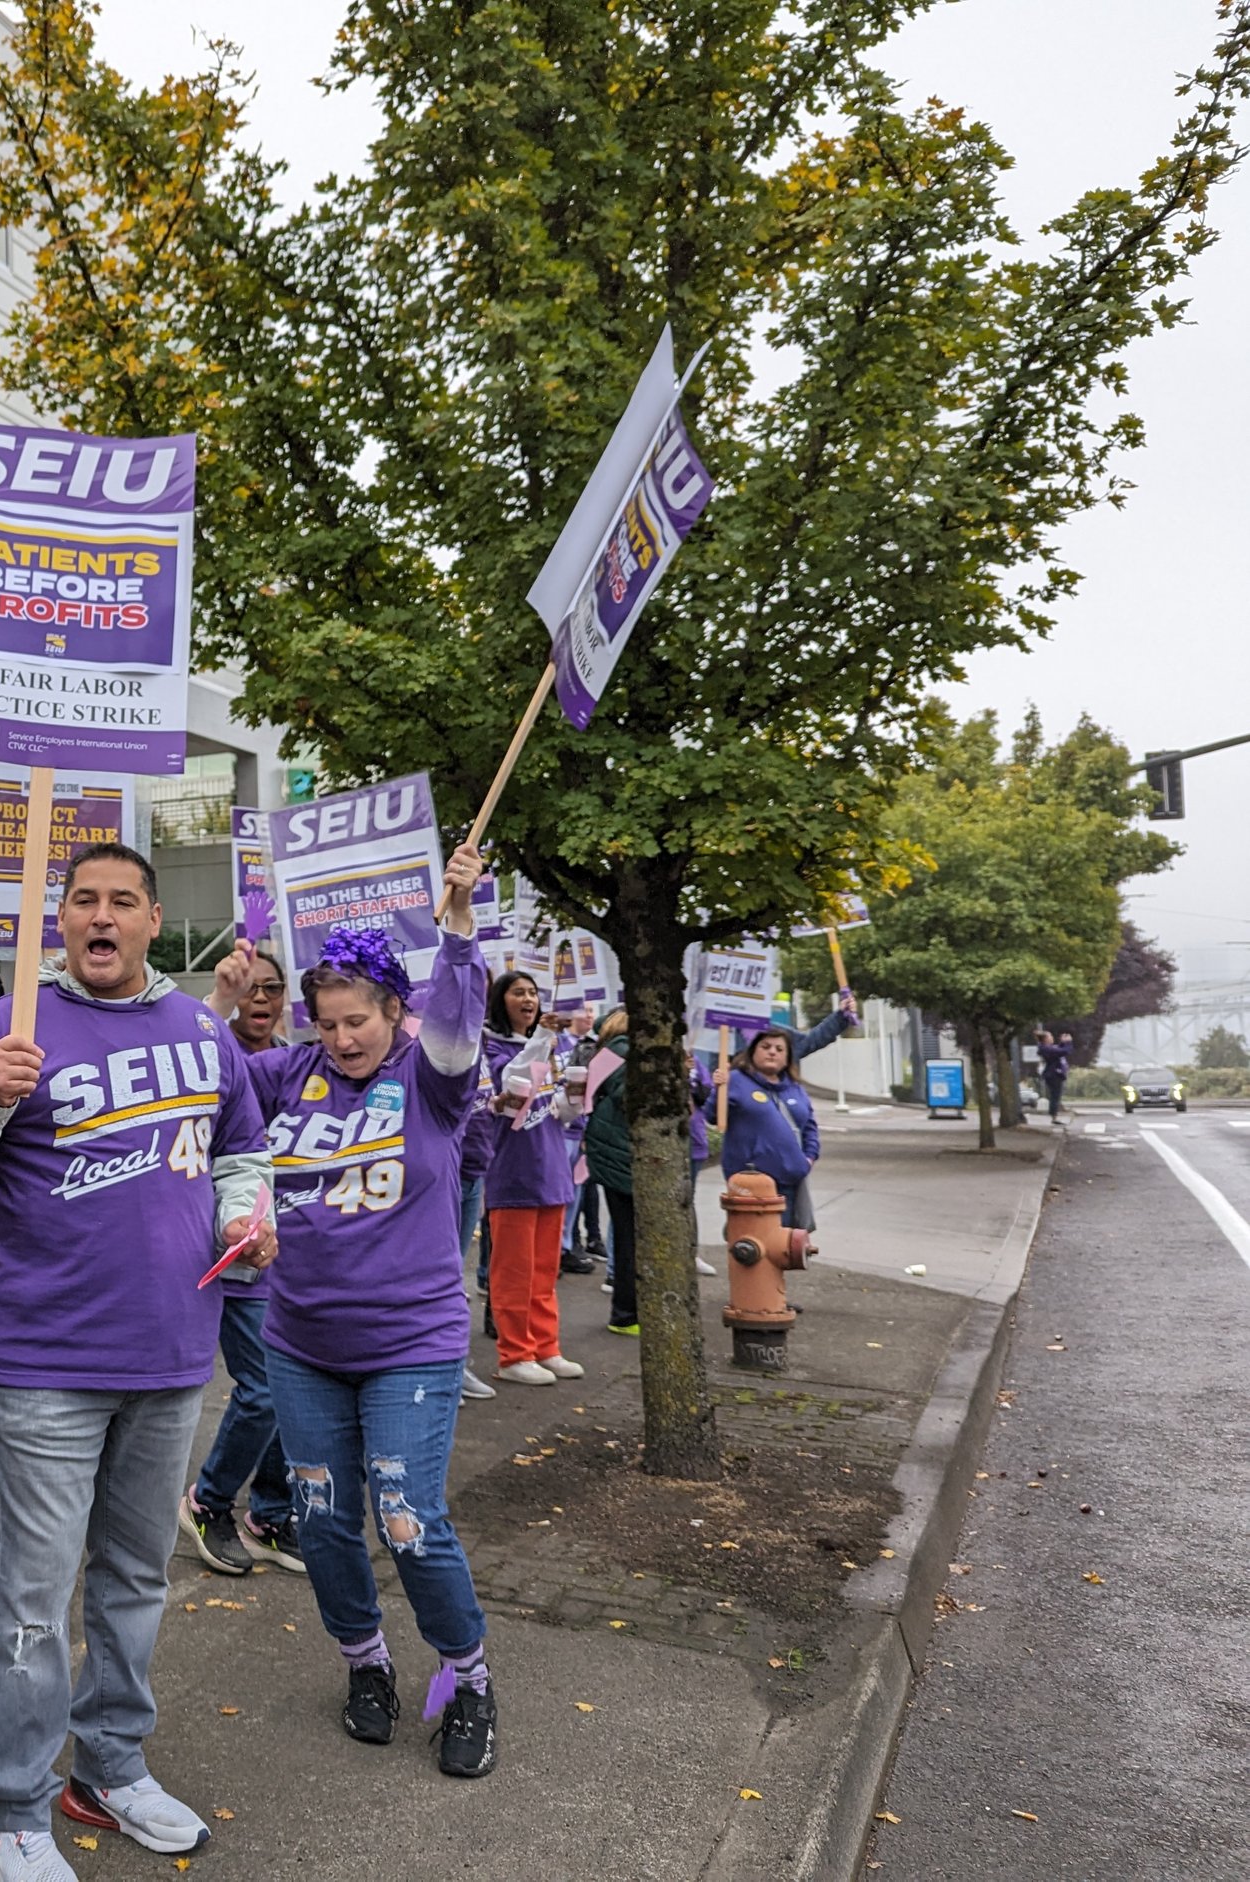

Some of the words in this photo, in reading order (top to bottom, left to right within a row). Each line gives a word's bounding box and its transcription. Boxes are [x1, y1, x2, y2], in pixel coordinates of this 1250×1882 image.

[655, 430, 704, 510] IU
[60, 675, 144, 697] LABOR
[72, 704, 162, 725] STRIKE
[8, 731, 34, 742] Service
[35, 734, 75, 747] Employees
[76, 738, 123, 750] International
[124, 742, 148, 751] Union
[285, 785, 415, 853] SEIU
[294, 905, 347, 929] SHORT
[348, 891, 430, 917] STAFFING
[296, 894, 327, 912] END
[329, 888, 362, 906] THE
[364, 876, 424, 898] KAISER
[731, 963, 744, 985] in
[744, 965, 766, 988] US!
[49, 1040, 221, 1126] SEIU
[50, 1129, 161, 1196] Local
[167, 1116, 213, 1180] 49
[266, 1109, 405, 1159] SEIU
[325, 1159, 405, 1215] 49
